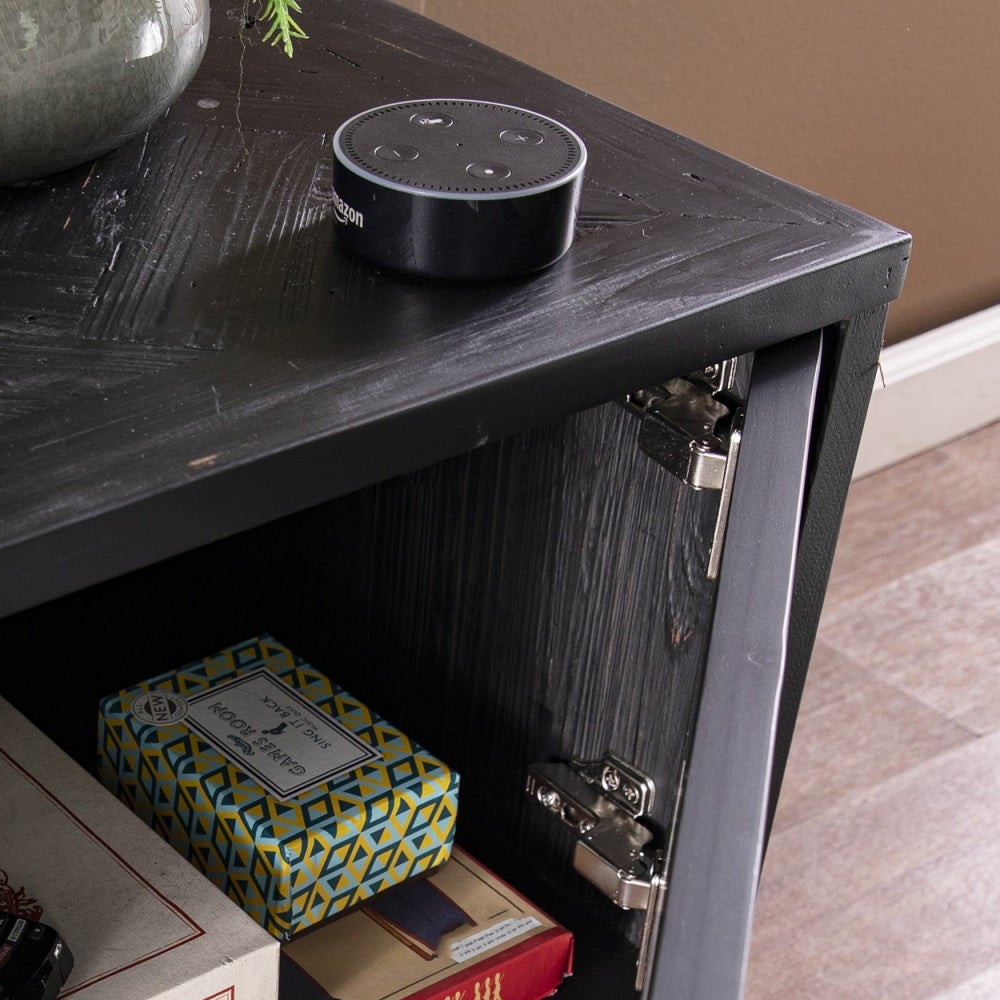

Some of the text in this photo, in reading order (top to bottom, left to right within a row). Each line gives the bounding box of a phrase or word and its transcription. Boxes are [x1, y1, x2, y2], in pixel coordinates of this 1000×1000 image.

[331, 186, 364, 228] azon
[150, 694, 169, 721] NEW
[207, 701, 255, 737] ROOM
[257, 695, 332, 749] SING IT BACK
[251, 735, 307, 777] GAMES
